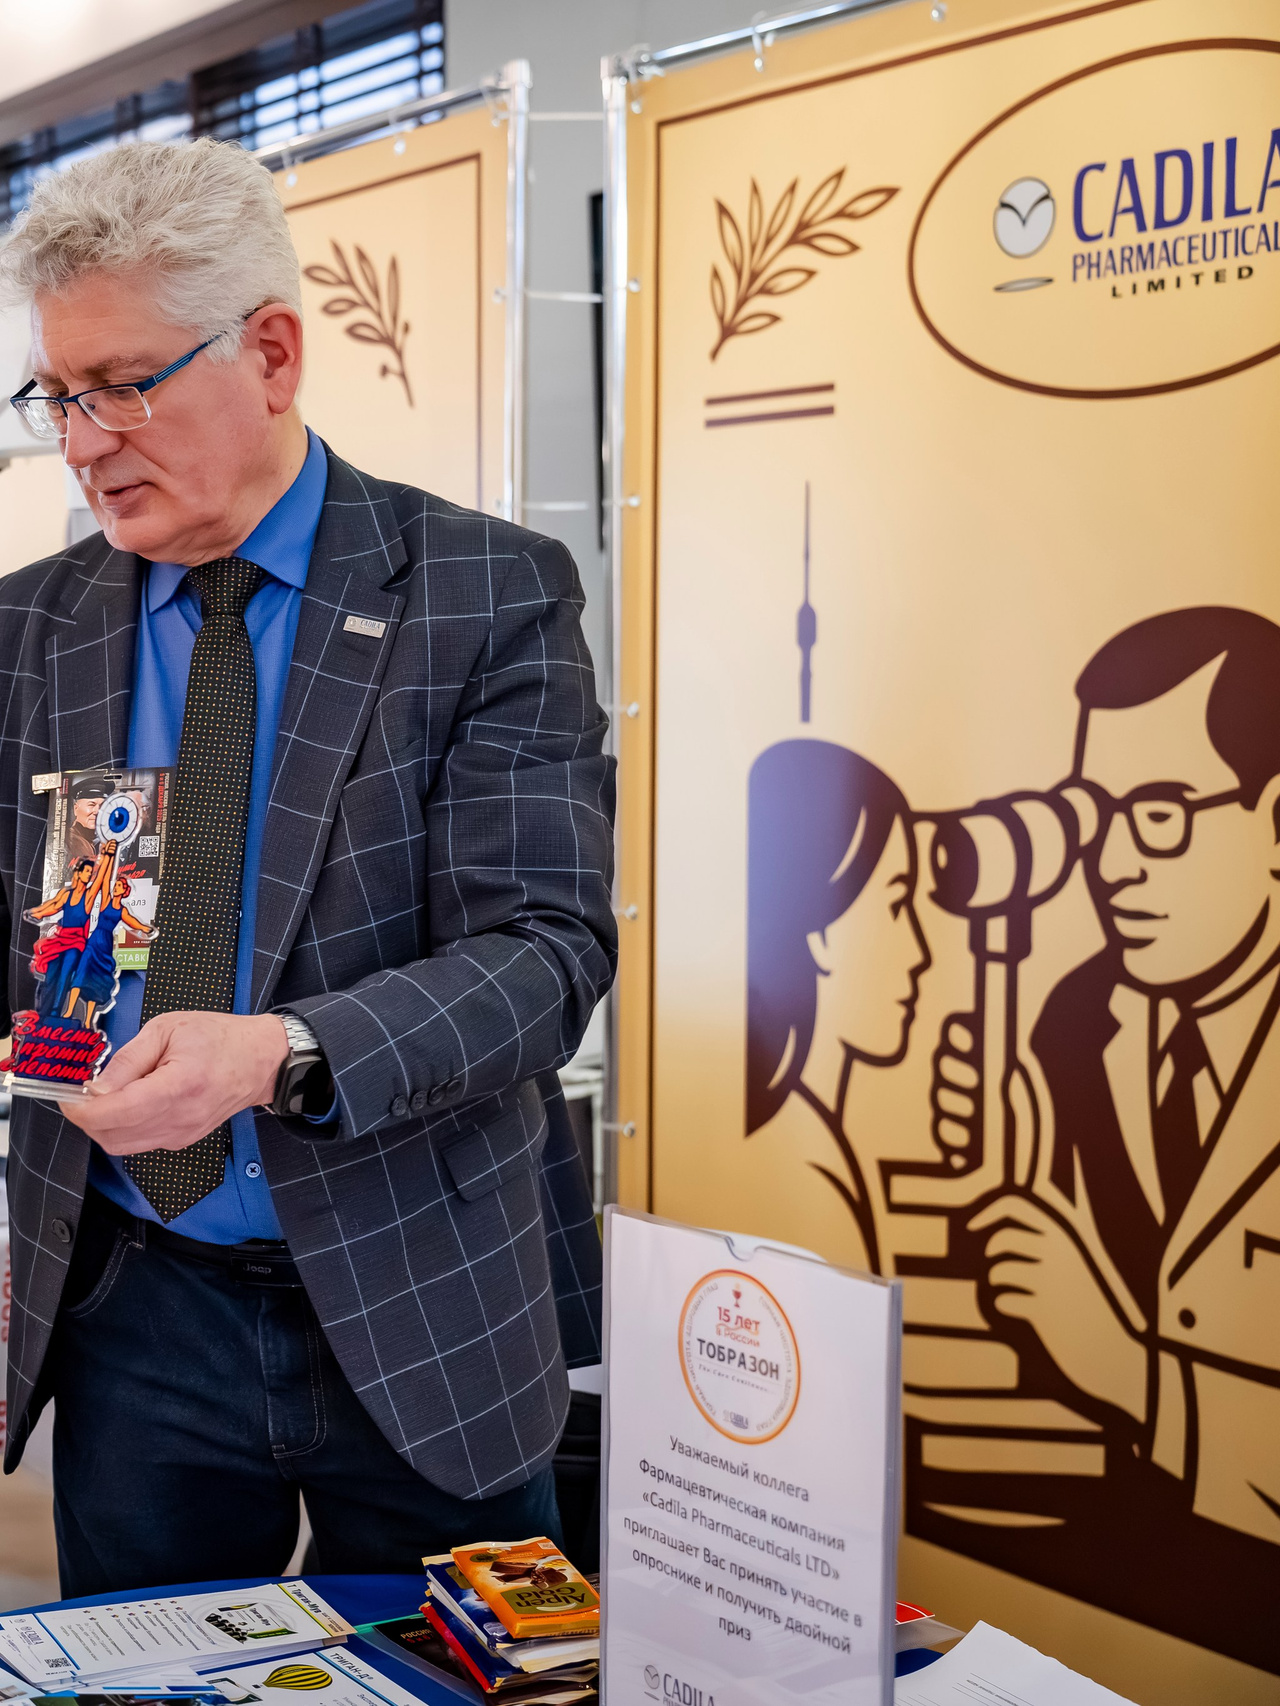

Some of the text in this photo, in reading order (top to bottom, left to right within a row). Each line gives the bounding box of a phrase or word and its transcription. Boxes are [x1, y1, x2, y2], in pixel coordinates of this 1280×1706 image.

[1111, 266, 1255, 298] LIMITED
[12, 1010, 101, 1045] Вместе
[15, 1041, 105, 1064] против
[717, 1306, 760, 1332] 15 лет
[723, 1329, 760, 1347] России
[696, 1338, 779, 1380] ТОБРАЗОН
[669, 1434, 809, 1502] Уважаемый коллега
[639, 1457, 845, 1552] Фармацевтическая компания
[642, 1491, 840, 1580] «Cadila Pharmaceuticals LTD»
[623, 1517, 863, 1628] приглашает Вас принять участие в
[516, 1586, 576, 1601] Gold
[516, 1592, 586, 1607] Alpen
[632, 1548, 851, 1655] опроснике и получить двойной
[719, 1617, 752, 1642] приз
